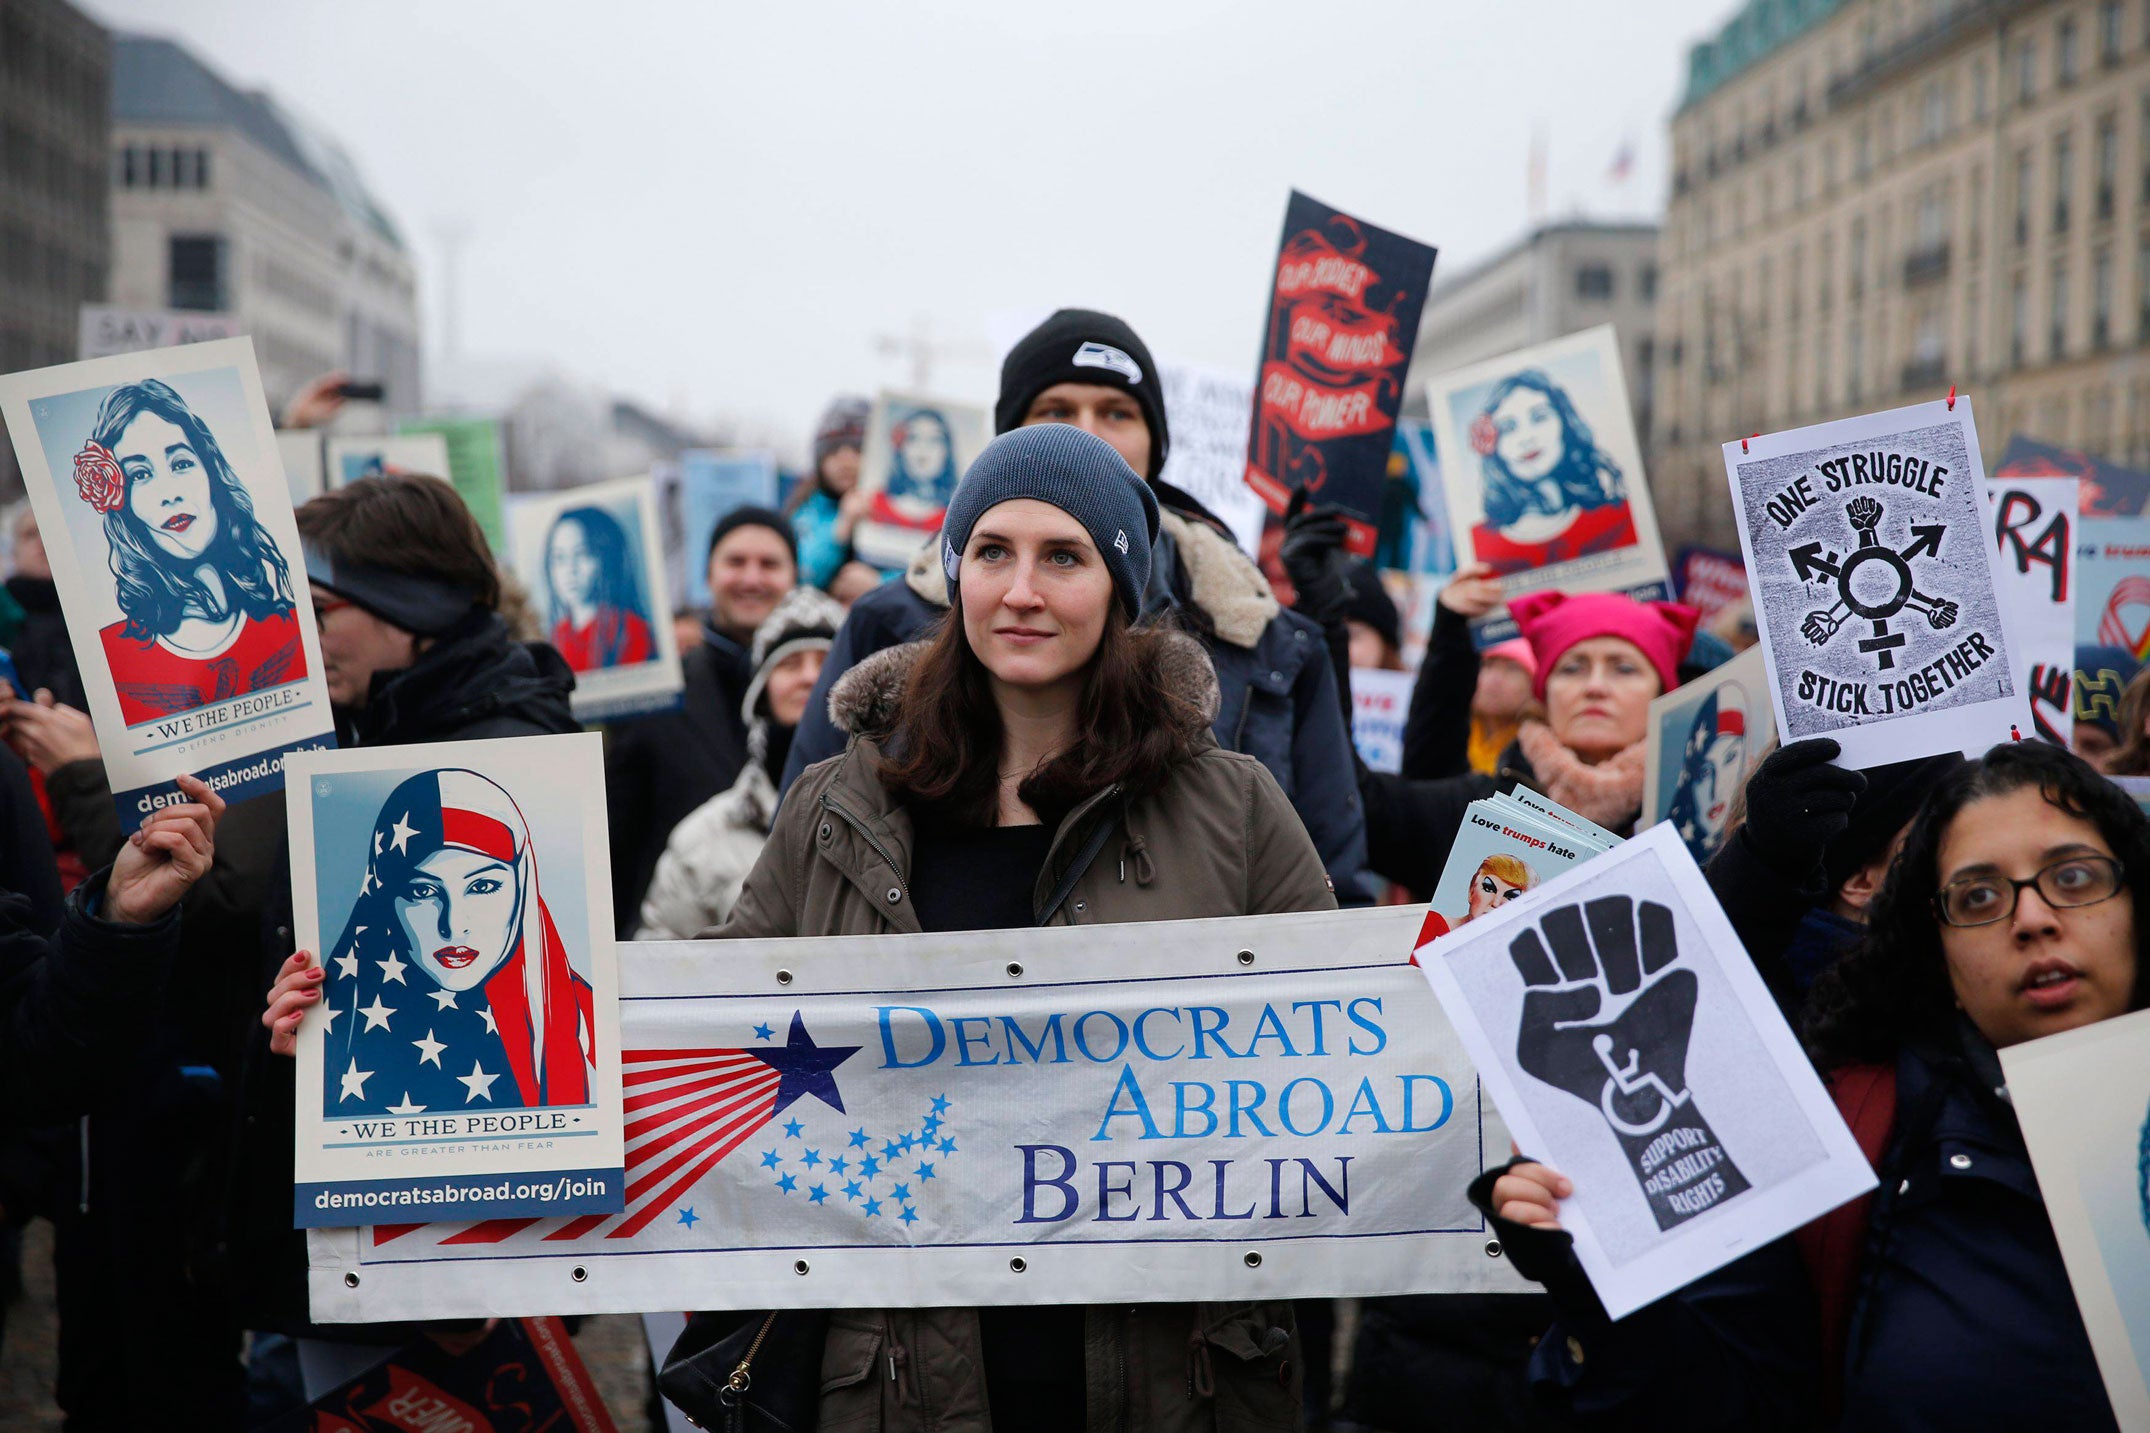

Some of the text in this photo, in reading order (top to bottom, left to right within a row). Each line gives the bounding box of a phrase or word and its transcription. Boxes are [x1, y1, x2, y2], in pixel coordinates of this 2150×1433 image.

[1277, 257, 1368, 297] OUR BODIES
[1291, 316, 1331, 349] OUR
[1263, 371, 1303, 412] OUR
[1299, 388, 1371, 430] POWER
[1766, 452, 1949, 528] ONE STRUGGLE
[1989, 487, 2069, 603] RA
[1798, 669, 1871, 715] STICK
[1878, 631, 1996, 715] TOGETHER
[157, 689, 293, 739] WE THE PEOPLE
[178, 716, 288, 754] DEFEND DIGNITY
[1470, 814, 1576, 860] Love trumps hate
[870, 997, 1388, 1070] DEMOCRATS
[353, 1113, 567, 1139] WE THE PEOPLE
[1089, 1062, 1454, 1142] ABROAD
[366, 1141, 554, 1158] ARE GREATER THAN FEAR
[1640, 1127, 1707, 1175] SUPPORT
[1644, 1145, 1723, 1195] DISABILITY
[314, 1177, 606, 1209] democratsabroad.org/join
[1012, 1144, 1356, 1225] BERLIN
[1667, 1172, 1725, 1214] RIGHTS
